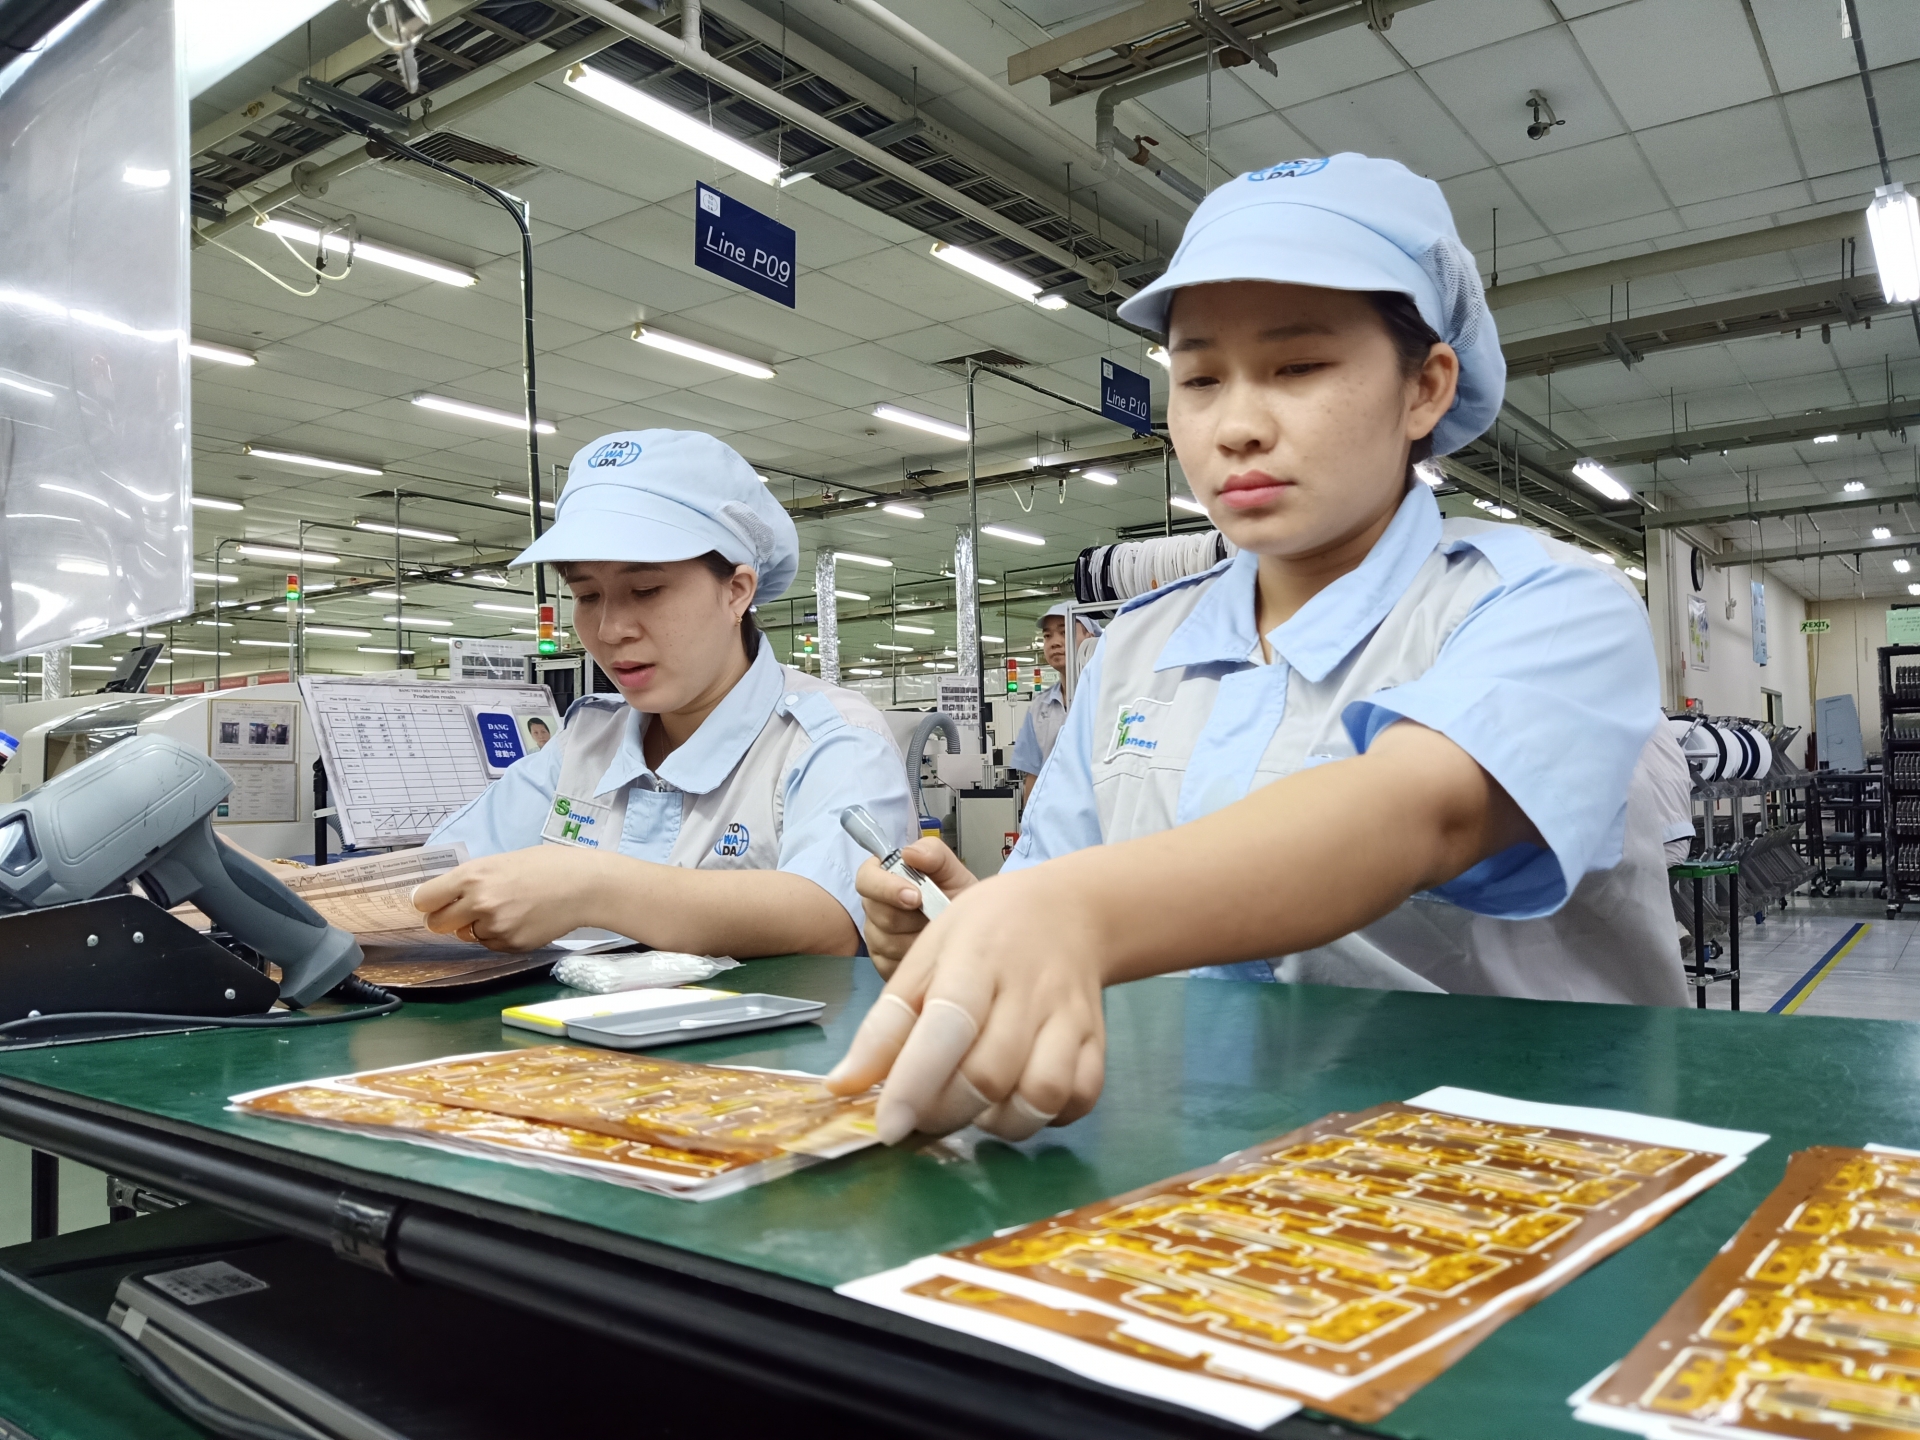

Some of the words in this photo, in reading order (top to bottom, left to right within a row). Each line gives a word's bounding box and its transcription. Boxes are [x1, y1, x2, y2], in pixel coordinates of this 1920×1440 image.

[1266, 170, 1296, 180] DA
[706, 225, 746, 262] Line
[752, 248, 791, 283] P09
[1106, 386, 1126, 409] Line
[1129, 396, 1147, 417] P10
[612, 441, 630, 449] TO
[605, 450, 624, 458] WA
[597, 458, 617, 467] DA
[555, 798, 595, 825] Simple
[728, 823, 740, 833] TO
[561, 820, 599, 849] Hone
[724, 834, 739, 846] WA
[722, 846, 737, 857] DA
